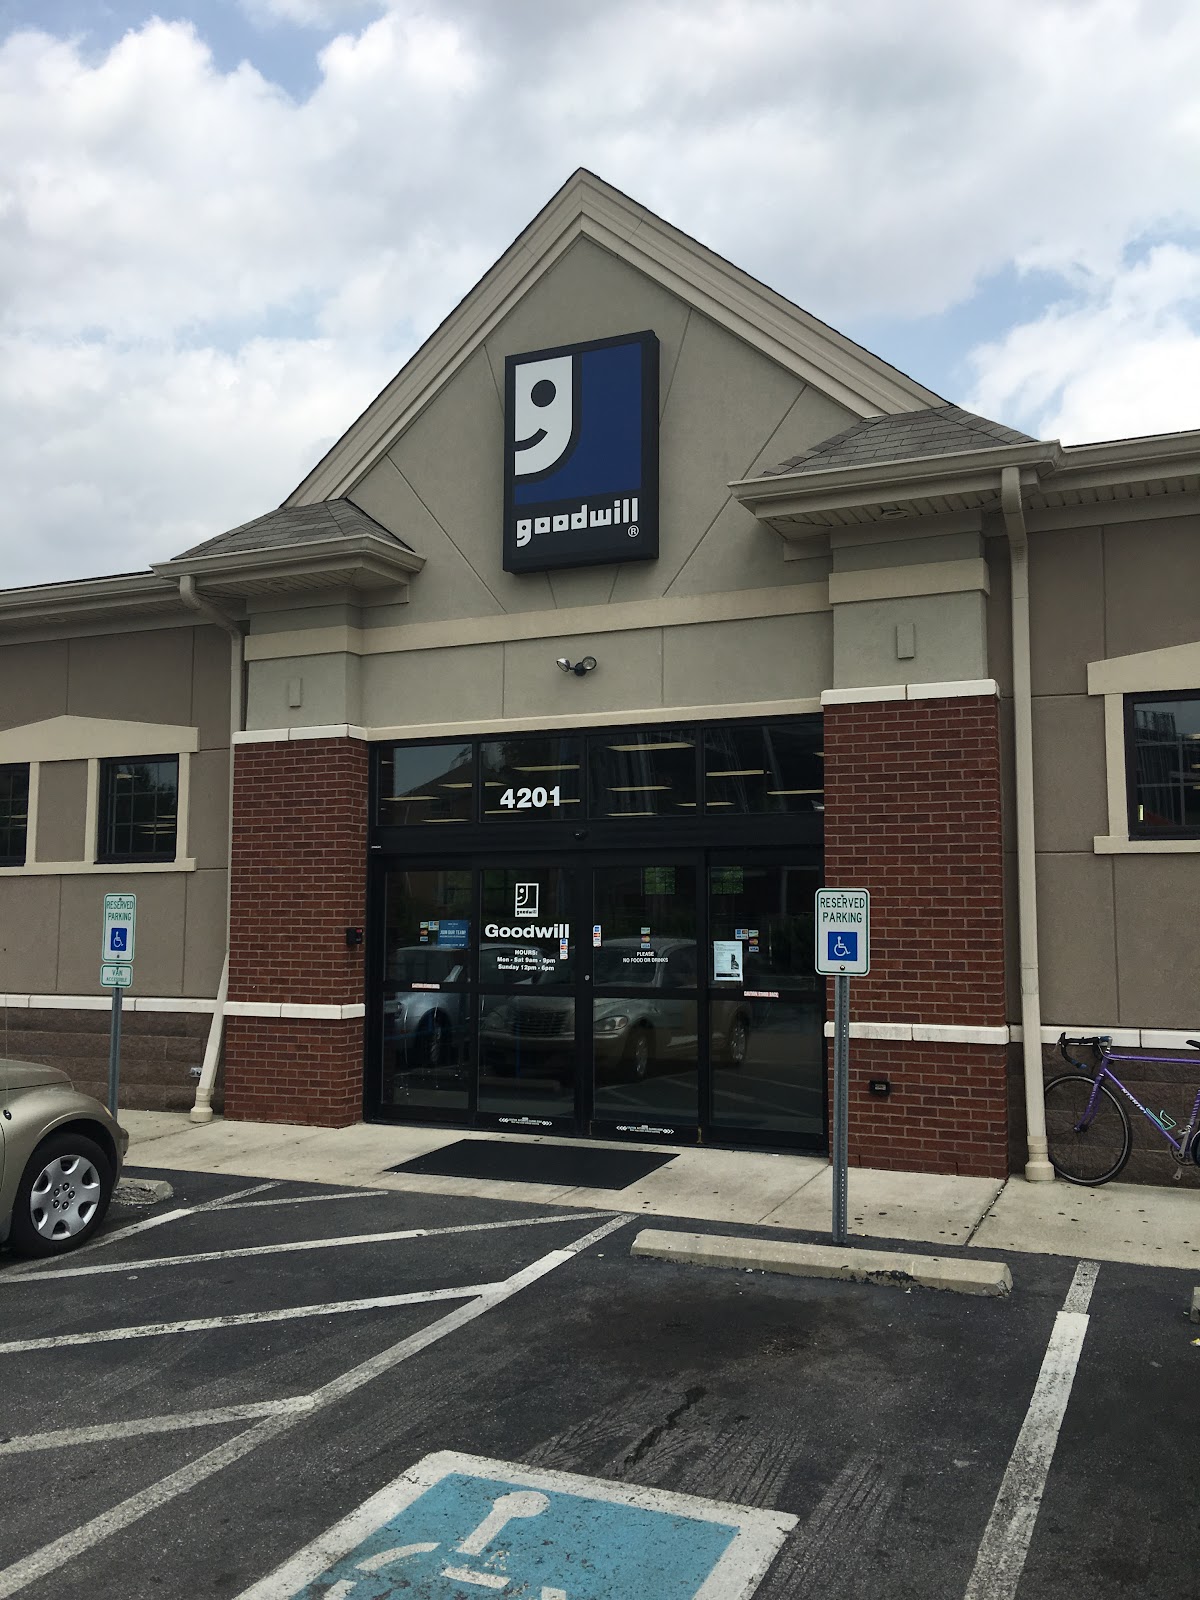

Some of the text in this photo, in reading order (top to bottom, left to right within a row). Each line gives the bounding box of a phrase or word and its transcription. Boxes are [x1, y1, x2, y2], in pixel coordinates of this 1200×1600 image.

[516, 497, 639, 548] goodwill
[499, 785, 561, 809] 4201
[106, 900, 134, 910] RESERVED
[820, 897, 865, 909] RESERVED
[107, 912, 132, 922] PARKING
[822, 911, 863, 923] PARKING
[484, 923, 570, 939] Goodwill
[111, 969, 123, 977] VAN
